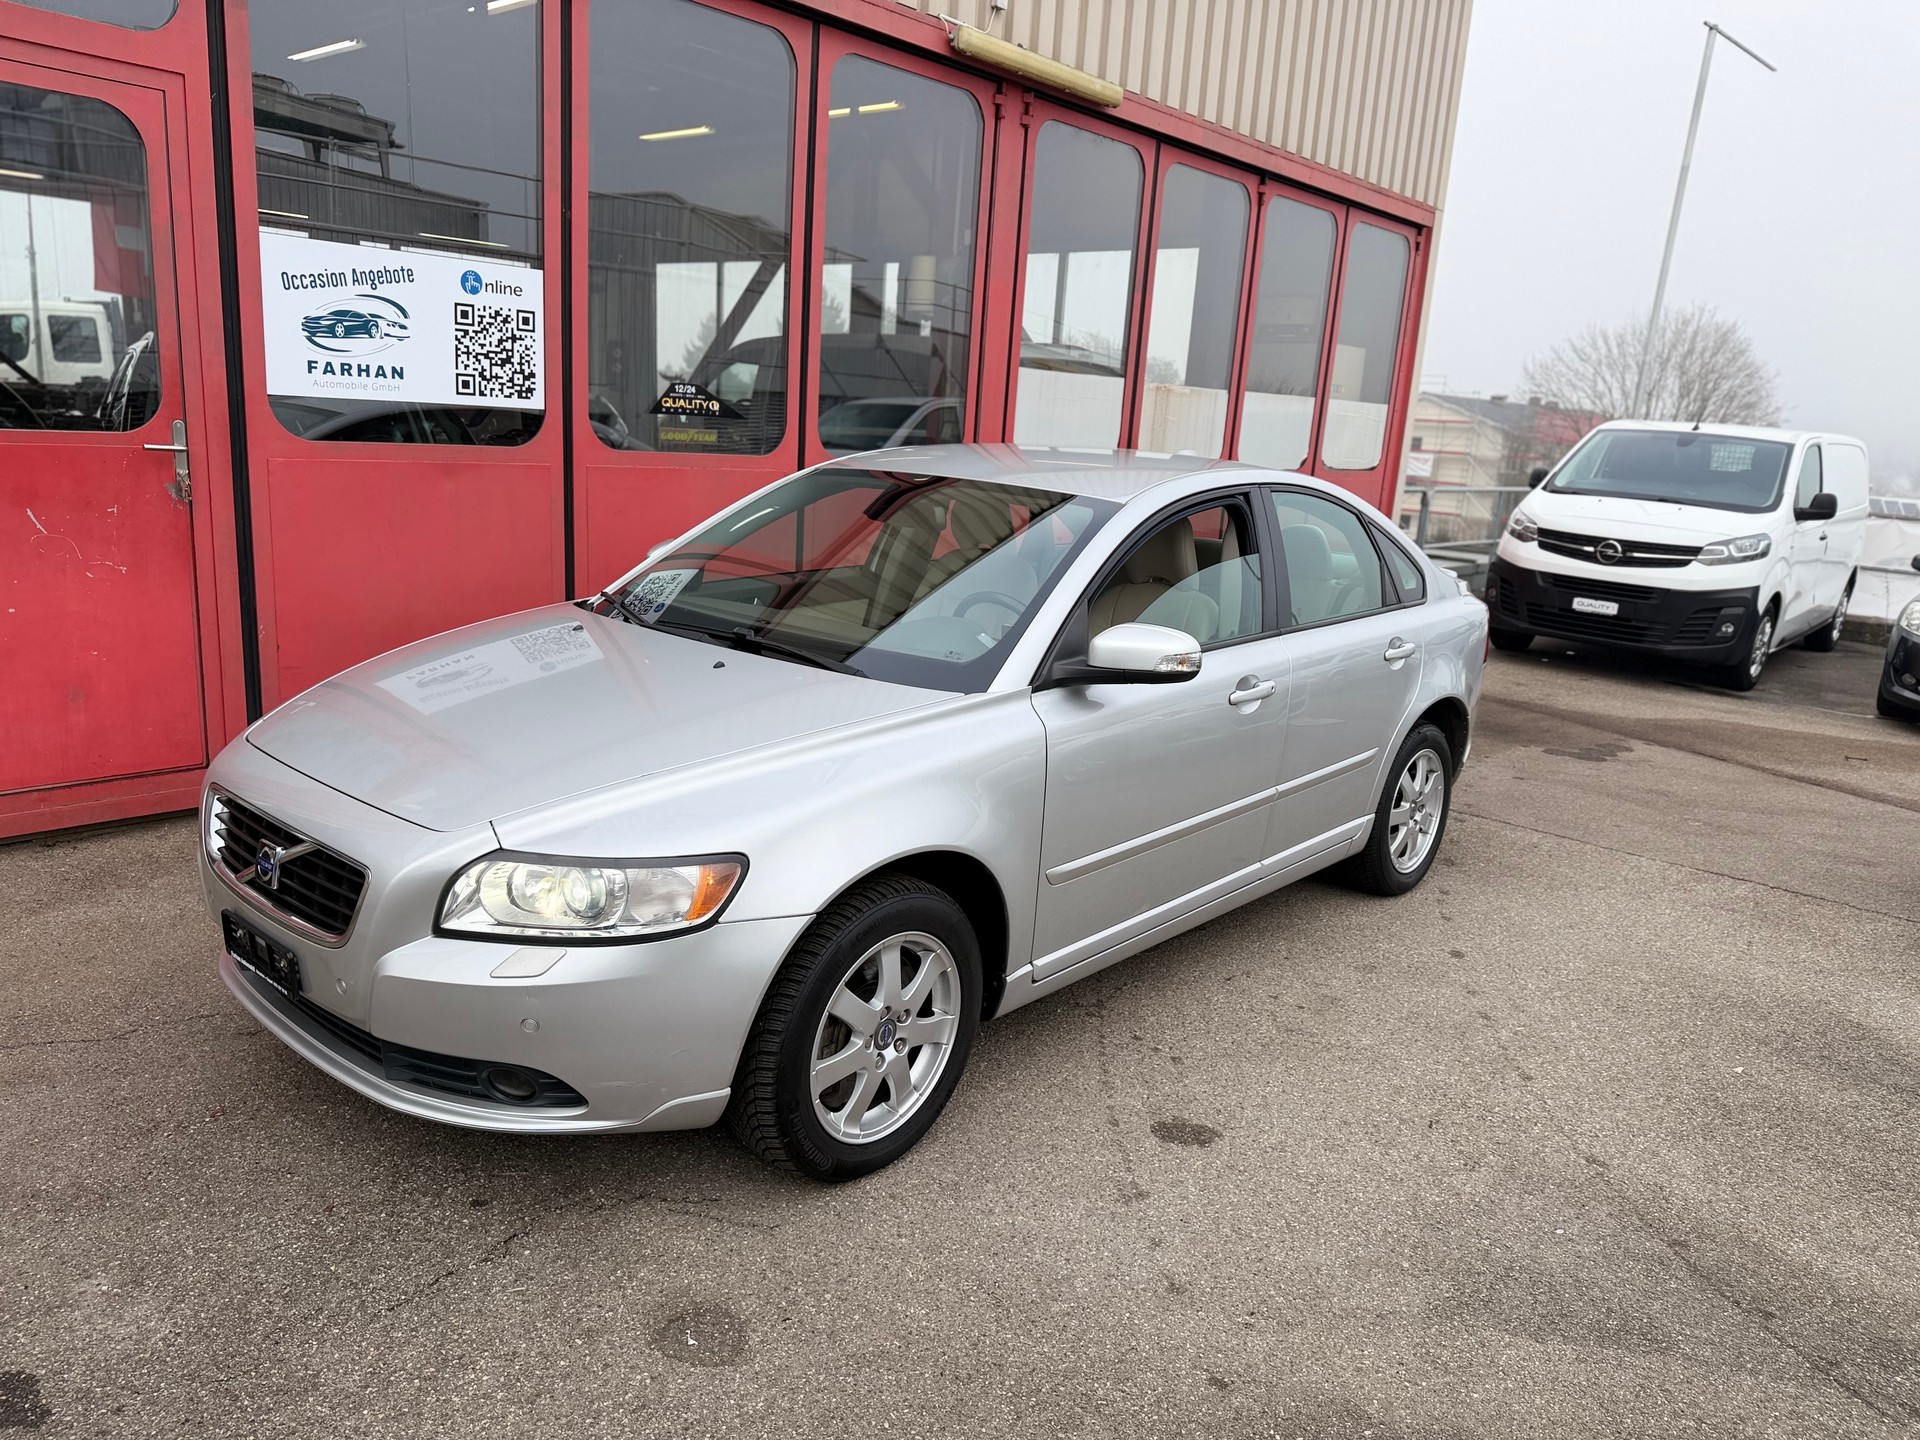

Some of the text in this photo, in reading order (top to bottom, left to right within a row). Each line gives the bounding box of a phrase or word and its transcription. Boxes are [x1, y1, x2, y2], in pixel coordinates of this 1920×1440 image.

[281, 265, 415, 291] Occasion Angebote
[307, 359, 405, 380] FARHAN
[312, 379, 401, 393] Automobile GmbH
[674, 384, 696, 394] 12/24
[660, 430, 717, 442] GOODYEAR
